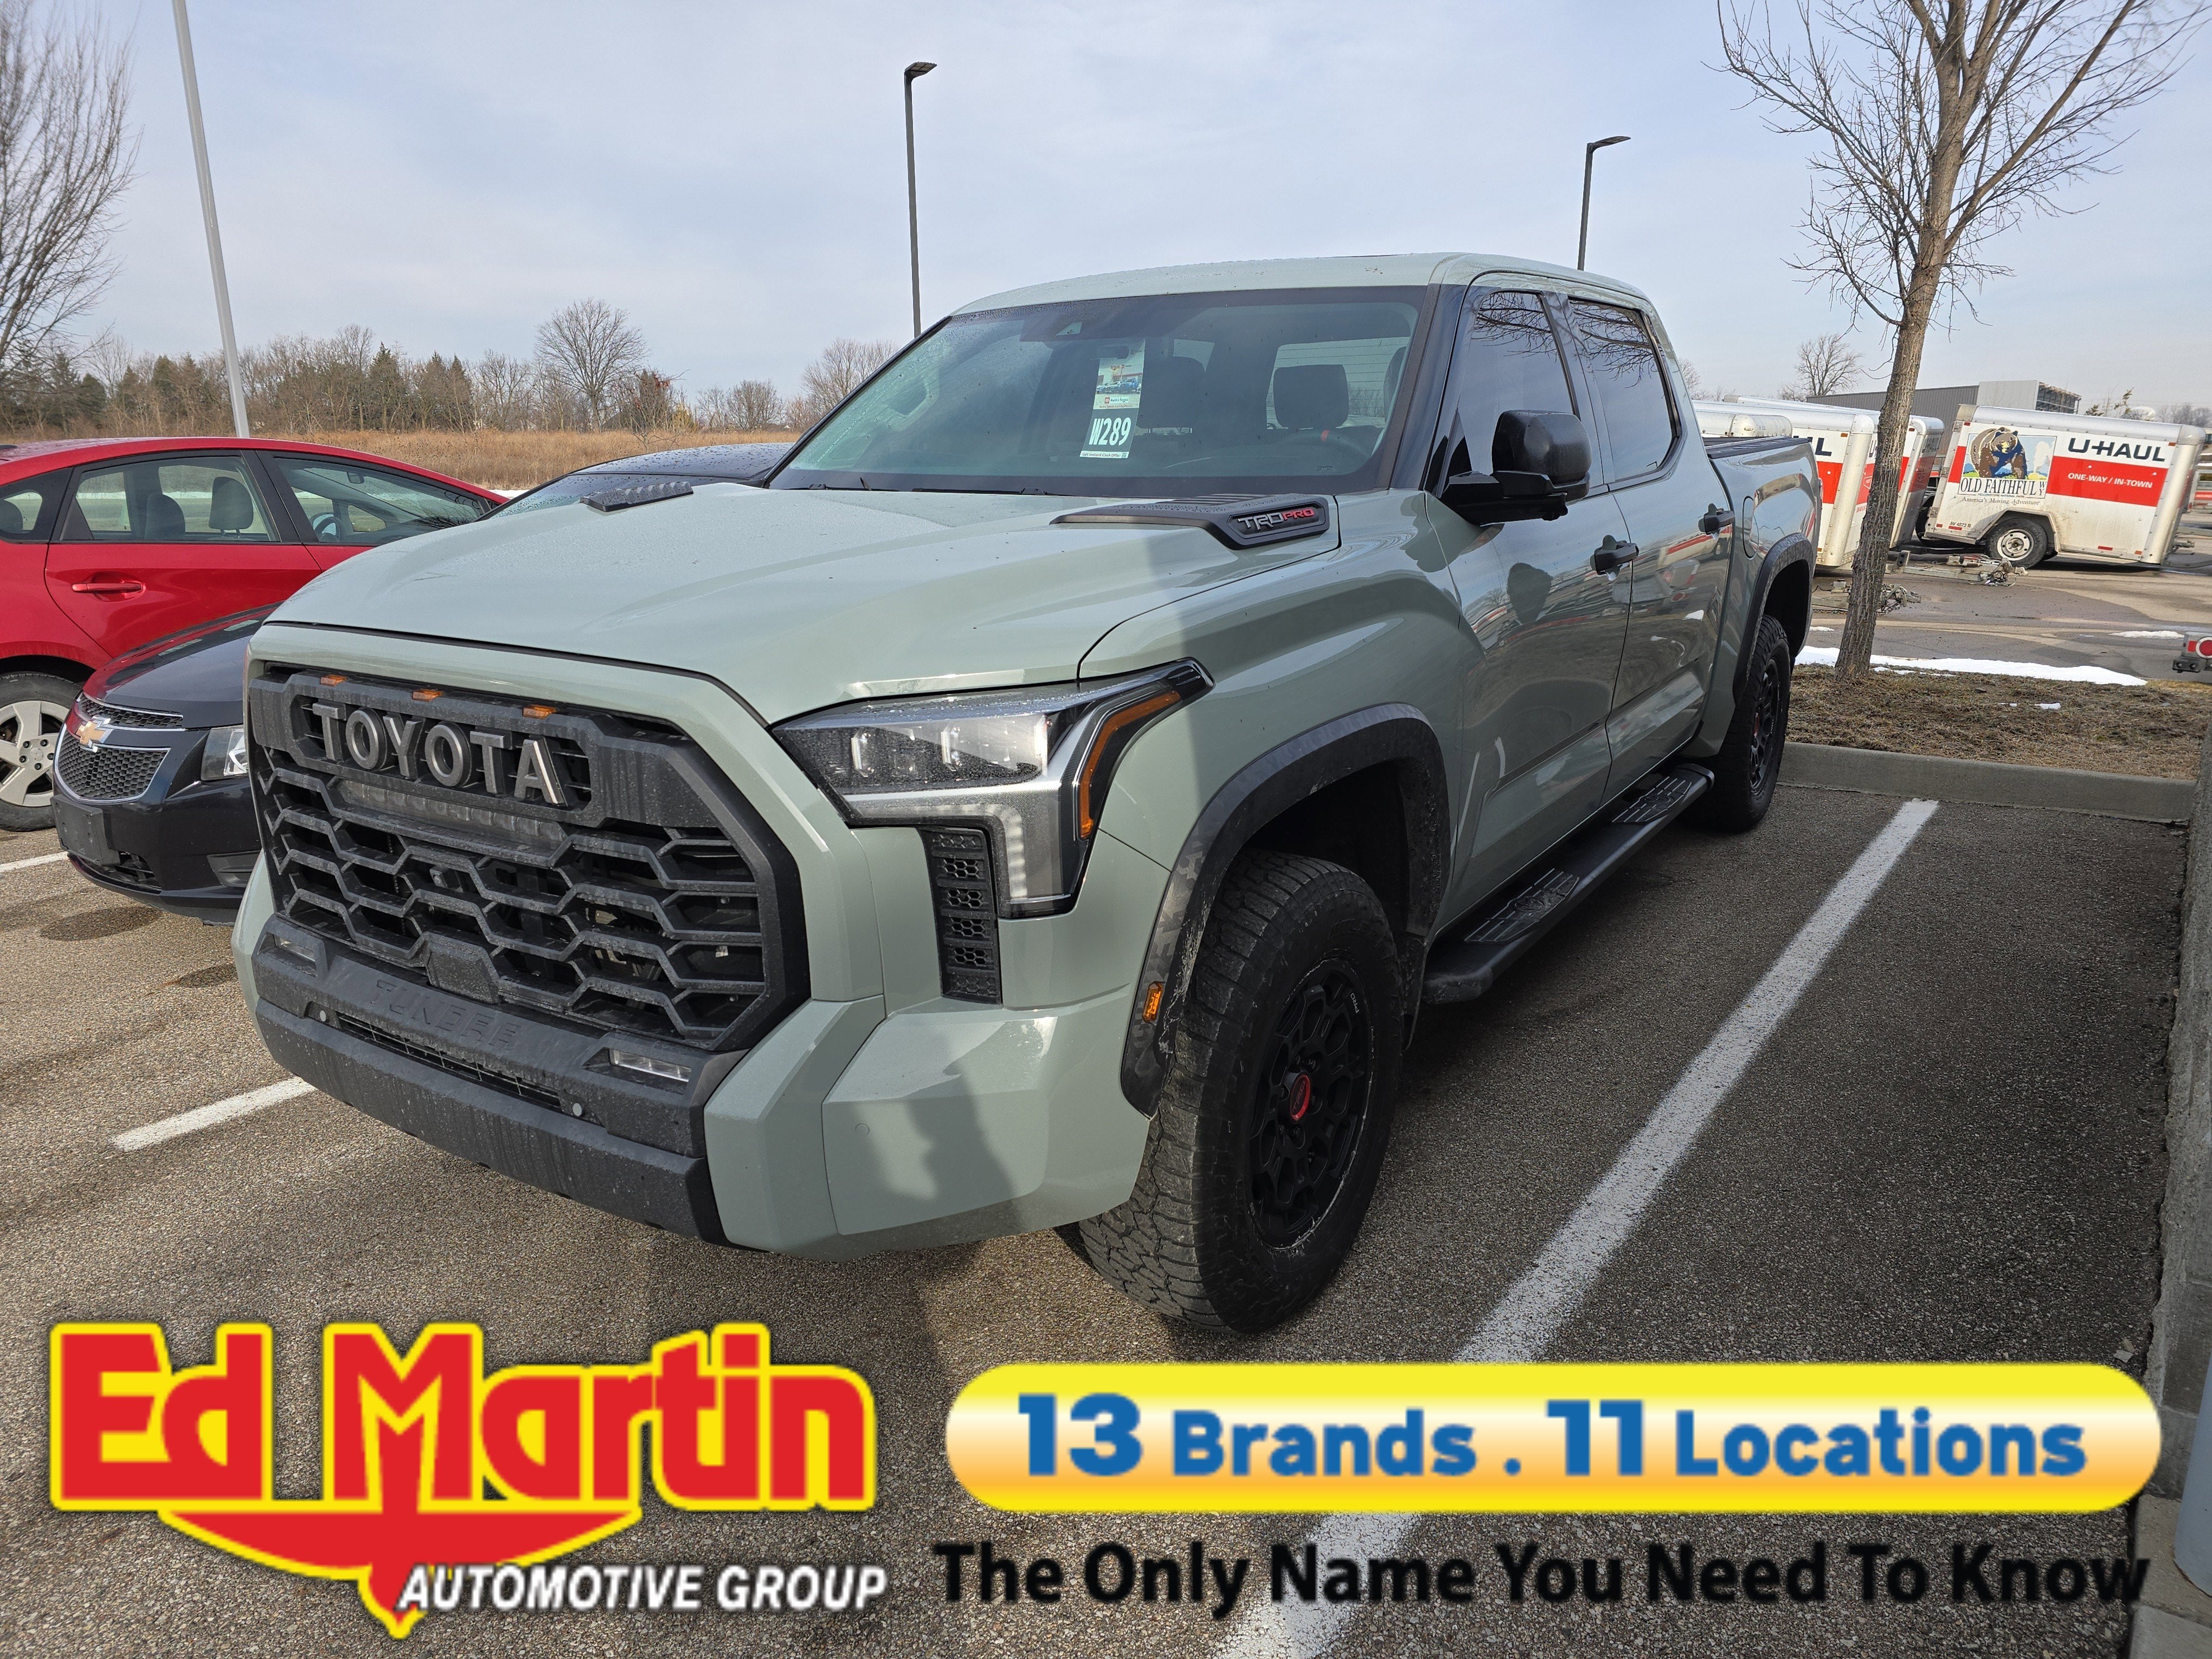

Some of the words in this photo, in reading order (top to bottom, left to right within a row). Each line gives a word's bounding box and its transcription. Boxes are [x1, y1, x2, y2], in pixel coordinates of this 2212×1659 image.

[1089, 417, 1131, 446] W289
[2068, 438, 2166, 462] U-HAUL
[1960, 477, 1982, 493] OLD
[1983, 479, 2038, 496] FAITHFUL
[2068, 472, 2107, 483] ONE-WAY
[2114, 478, 2153, 488] IN-TOWN
[1237, 512, 1284, 531] TRD
[1283, 507, 1315, 521] PRO
[312, 703, 566, 806] TOYOTA
